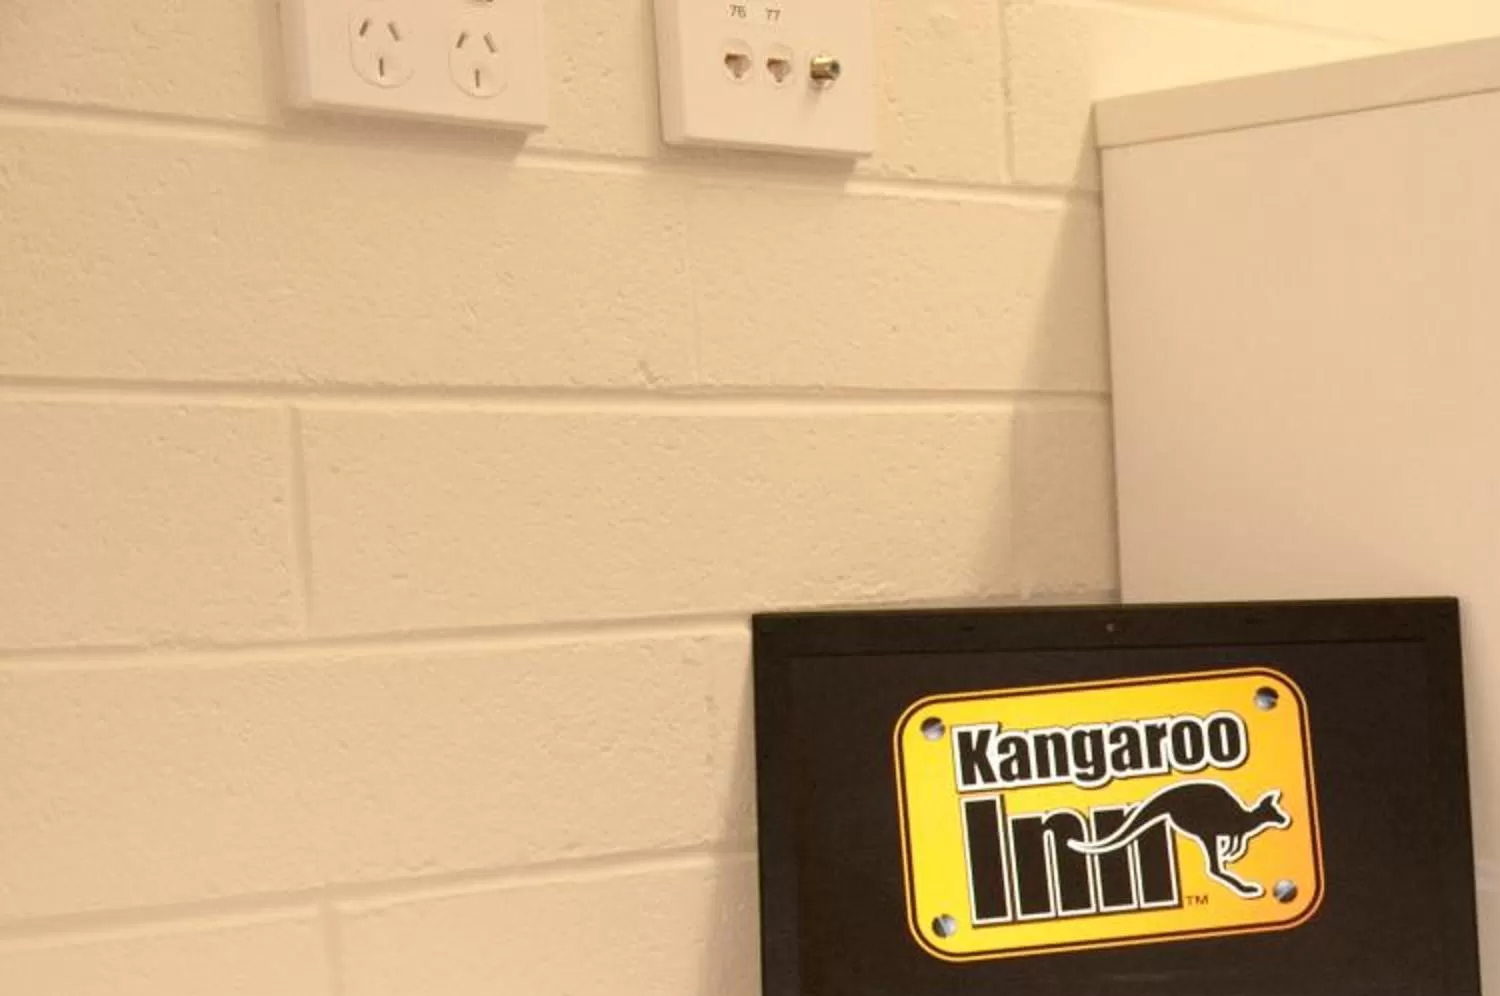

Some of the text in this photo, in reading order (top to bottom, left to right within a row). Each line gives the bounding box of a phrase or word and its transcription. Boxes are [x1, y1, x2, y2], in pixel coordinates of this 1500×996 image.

[764, 8, 782, 21] 77
[953, 713, 1245, 788] Kangaroo
[961, 796, 1180, 924] Inn
[1184, 895, 1209, 906] TM
